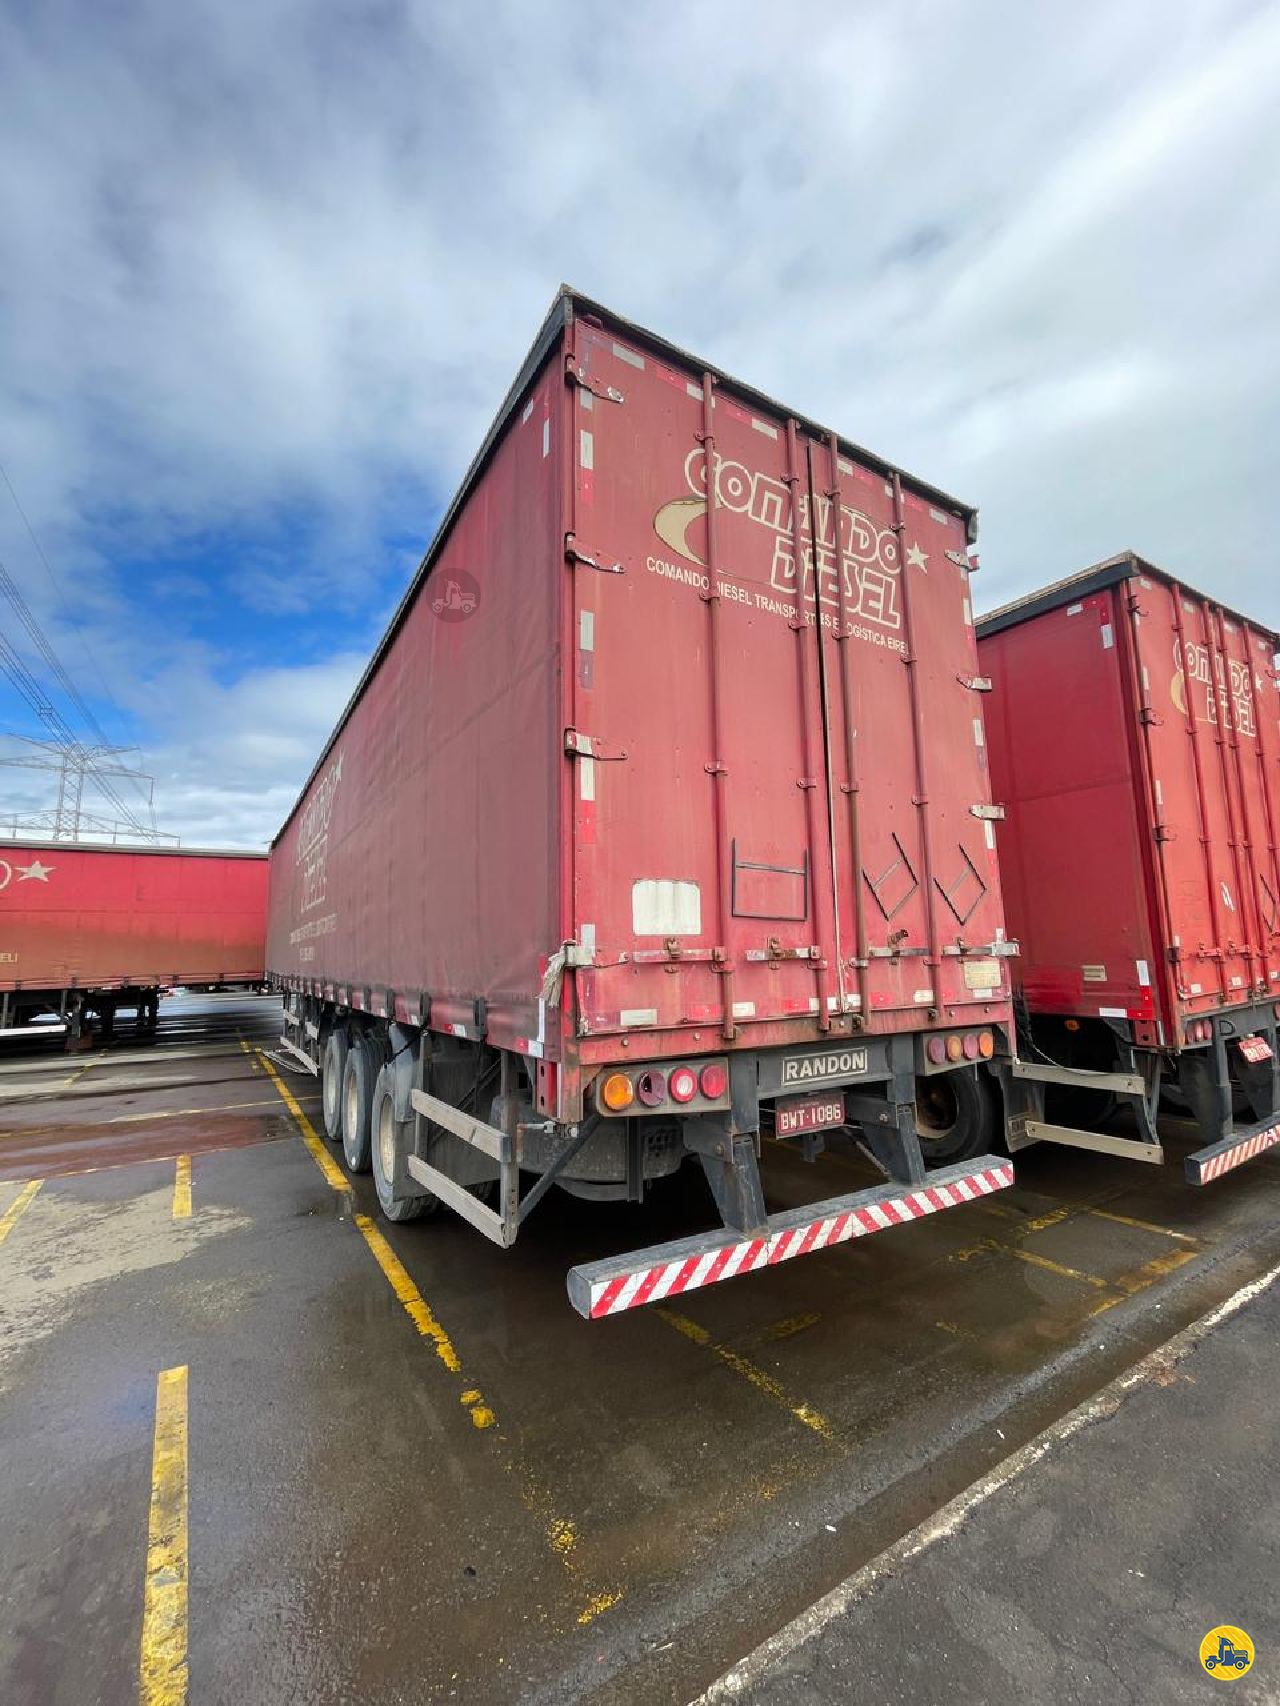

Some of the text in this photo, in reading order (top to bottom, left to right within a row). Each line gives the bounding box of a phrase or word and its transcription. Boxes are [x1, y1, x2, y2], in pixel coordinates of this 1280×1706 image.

[646, 556, 710, 590] COMANDO
[716, 581, 752, 606] IESEL
[786, 1052, 864, 1079] RANDON
